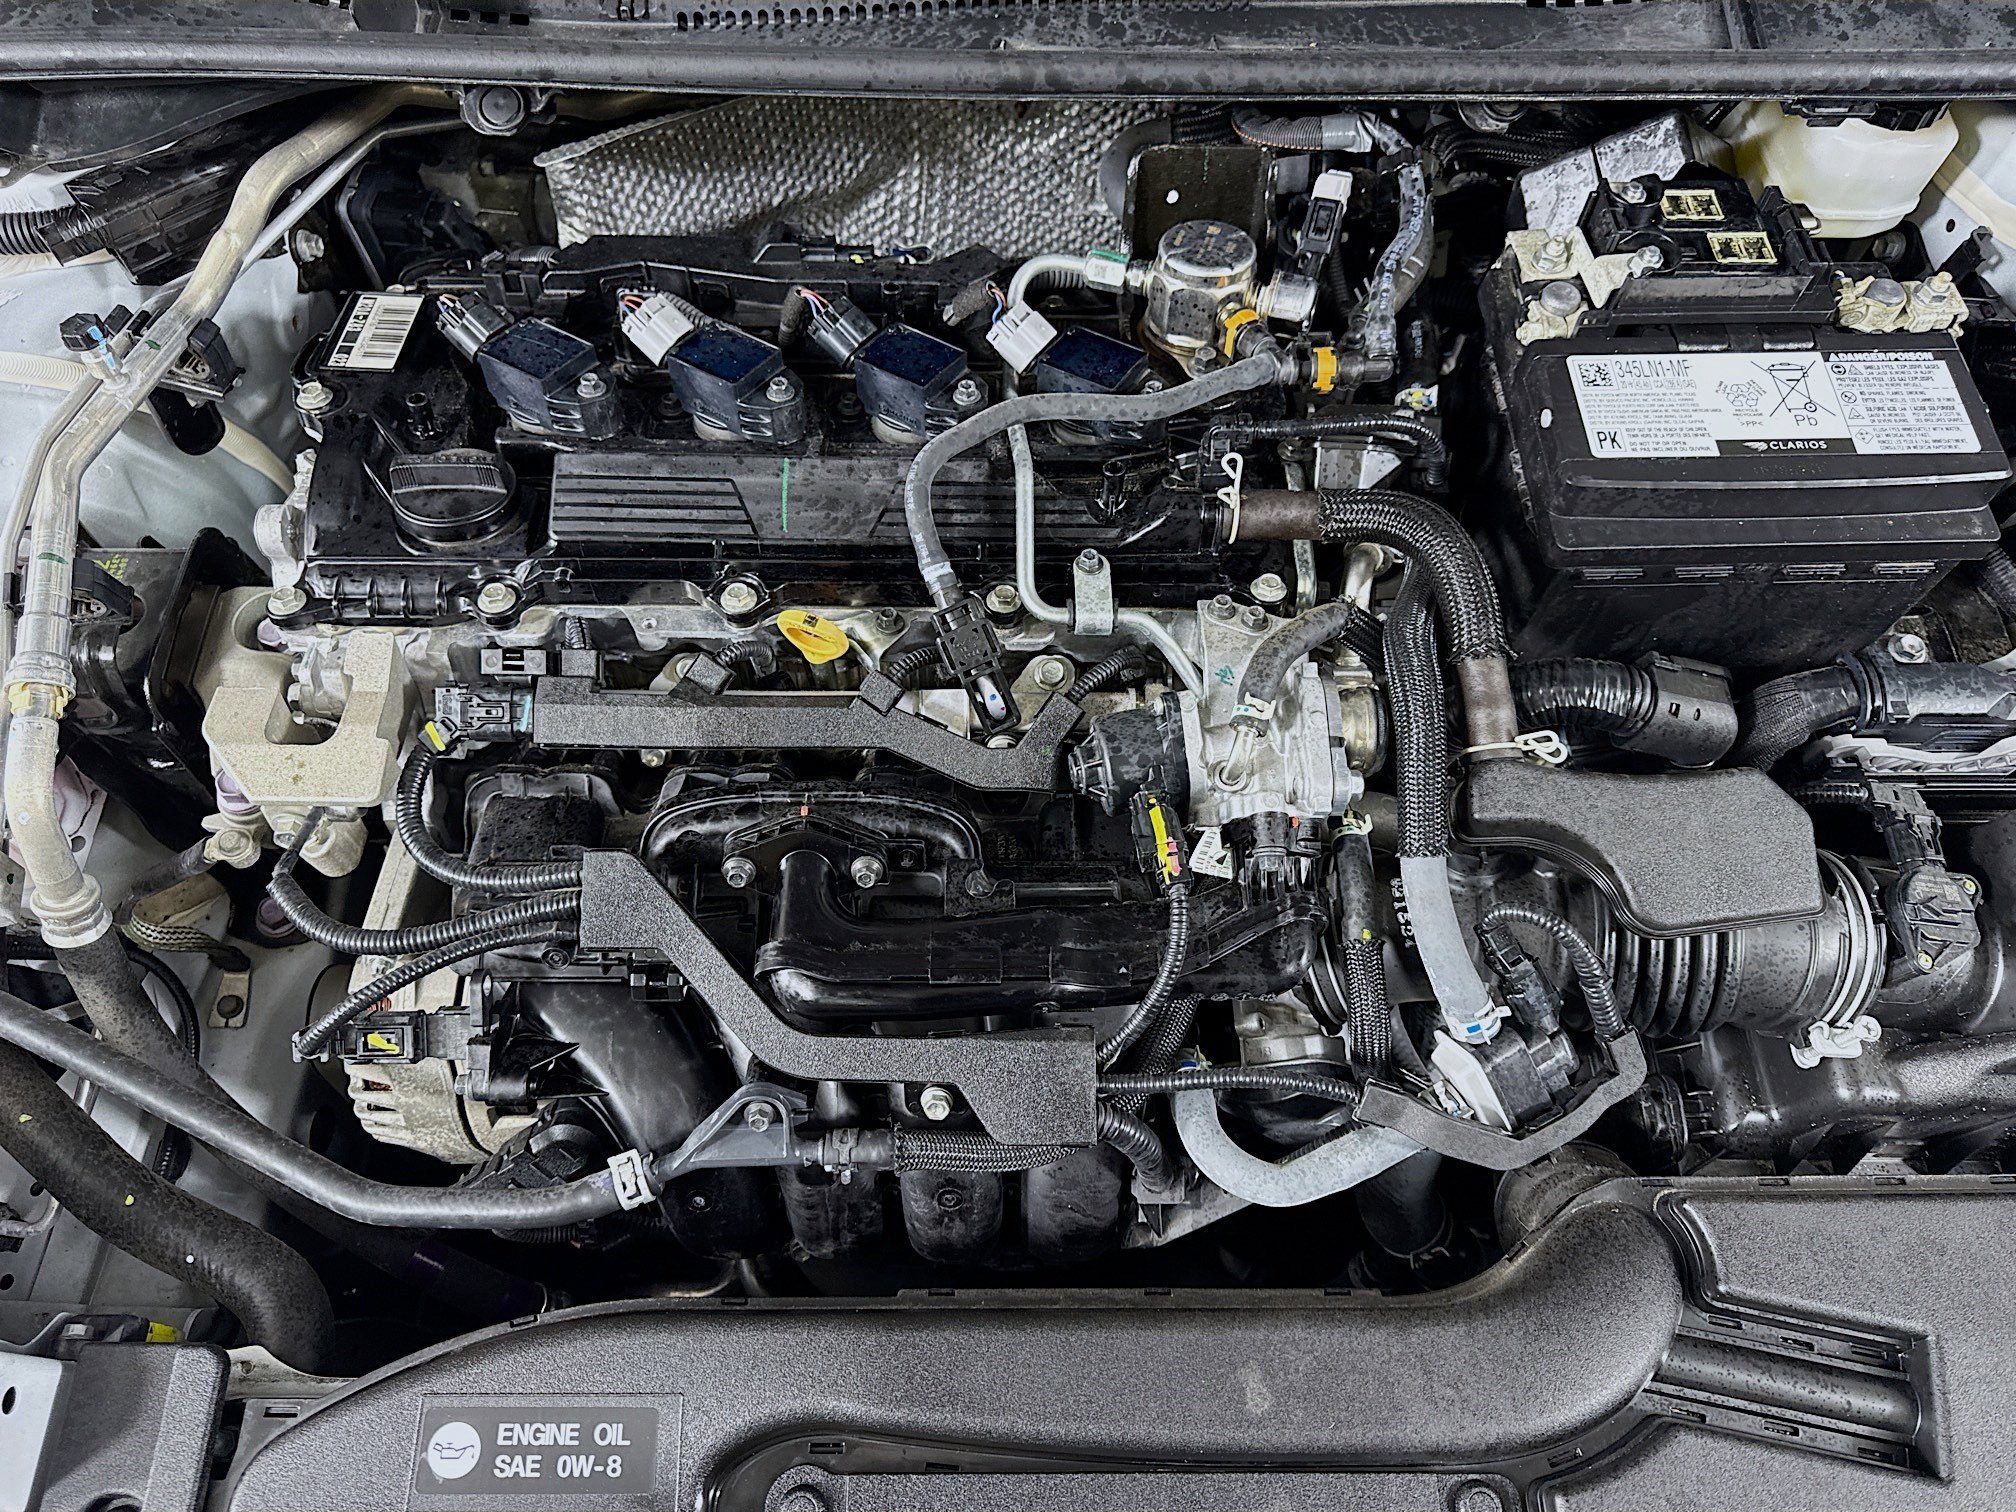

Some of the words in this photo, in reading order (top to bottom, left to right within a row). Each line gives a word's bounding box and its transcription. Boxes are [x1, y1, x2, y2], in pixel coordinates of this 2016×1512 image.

[1615, 359, 1690, 378] 345LN1-MF
[1794, 414, 1818, 426] Pb
[1597, 431, 1622, 449] PK
[1769, 440, 1827, 450] CLARIOS
[497, 1422, 580, 1446] ENGINE
[593, 1422, 631, 1446] OIL
[493, 1455, 542, 1478] SAE
[556, 1455, 622, 1478] 0W-8
